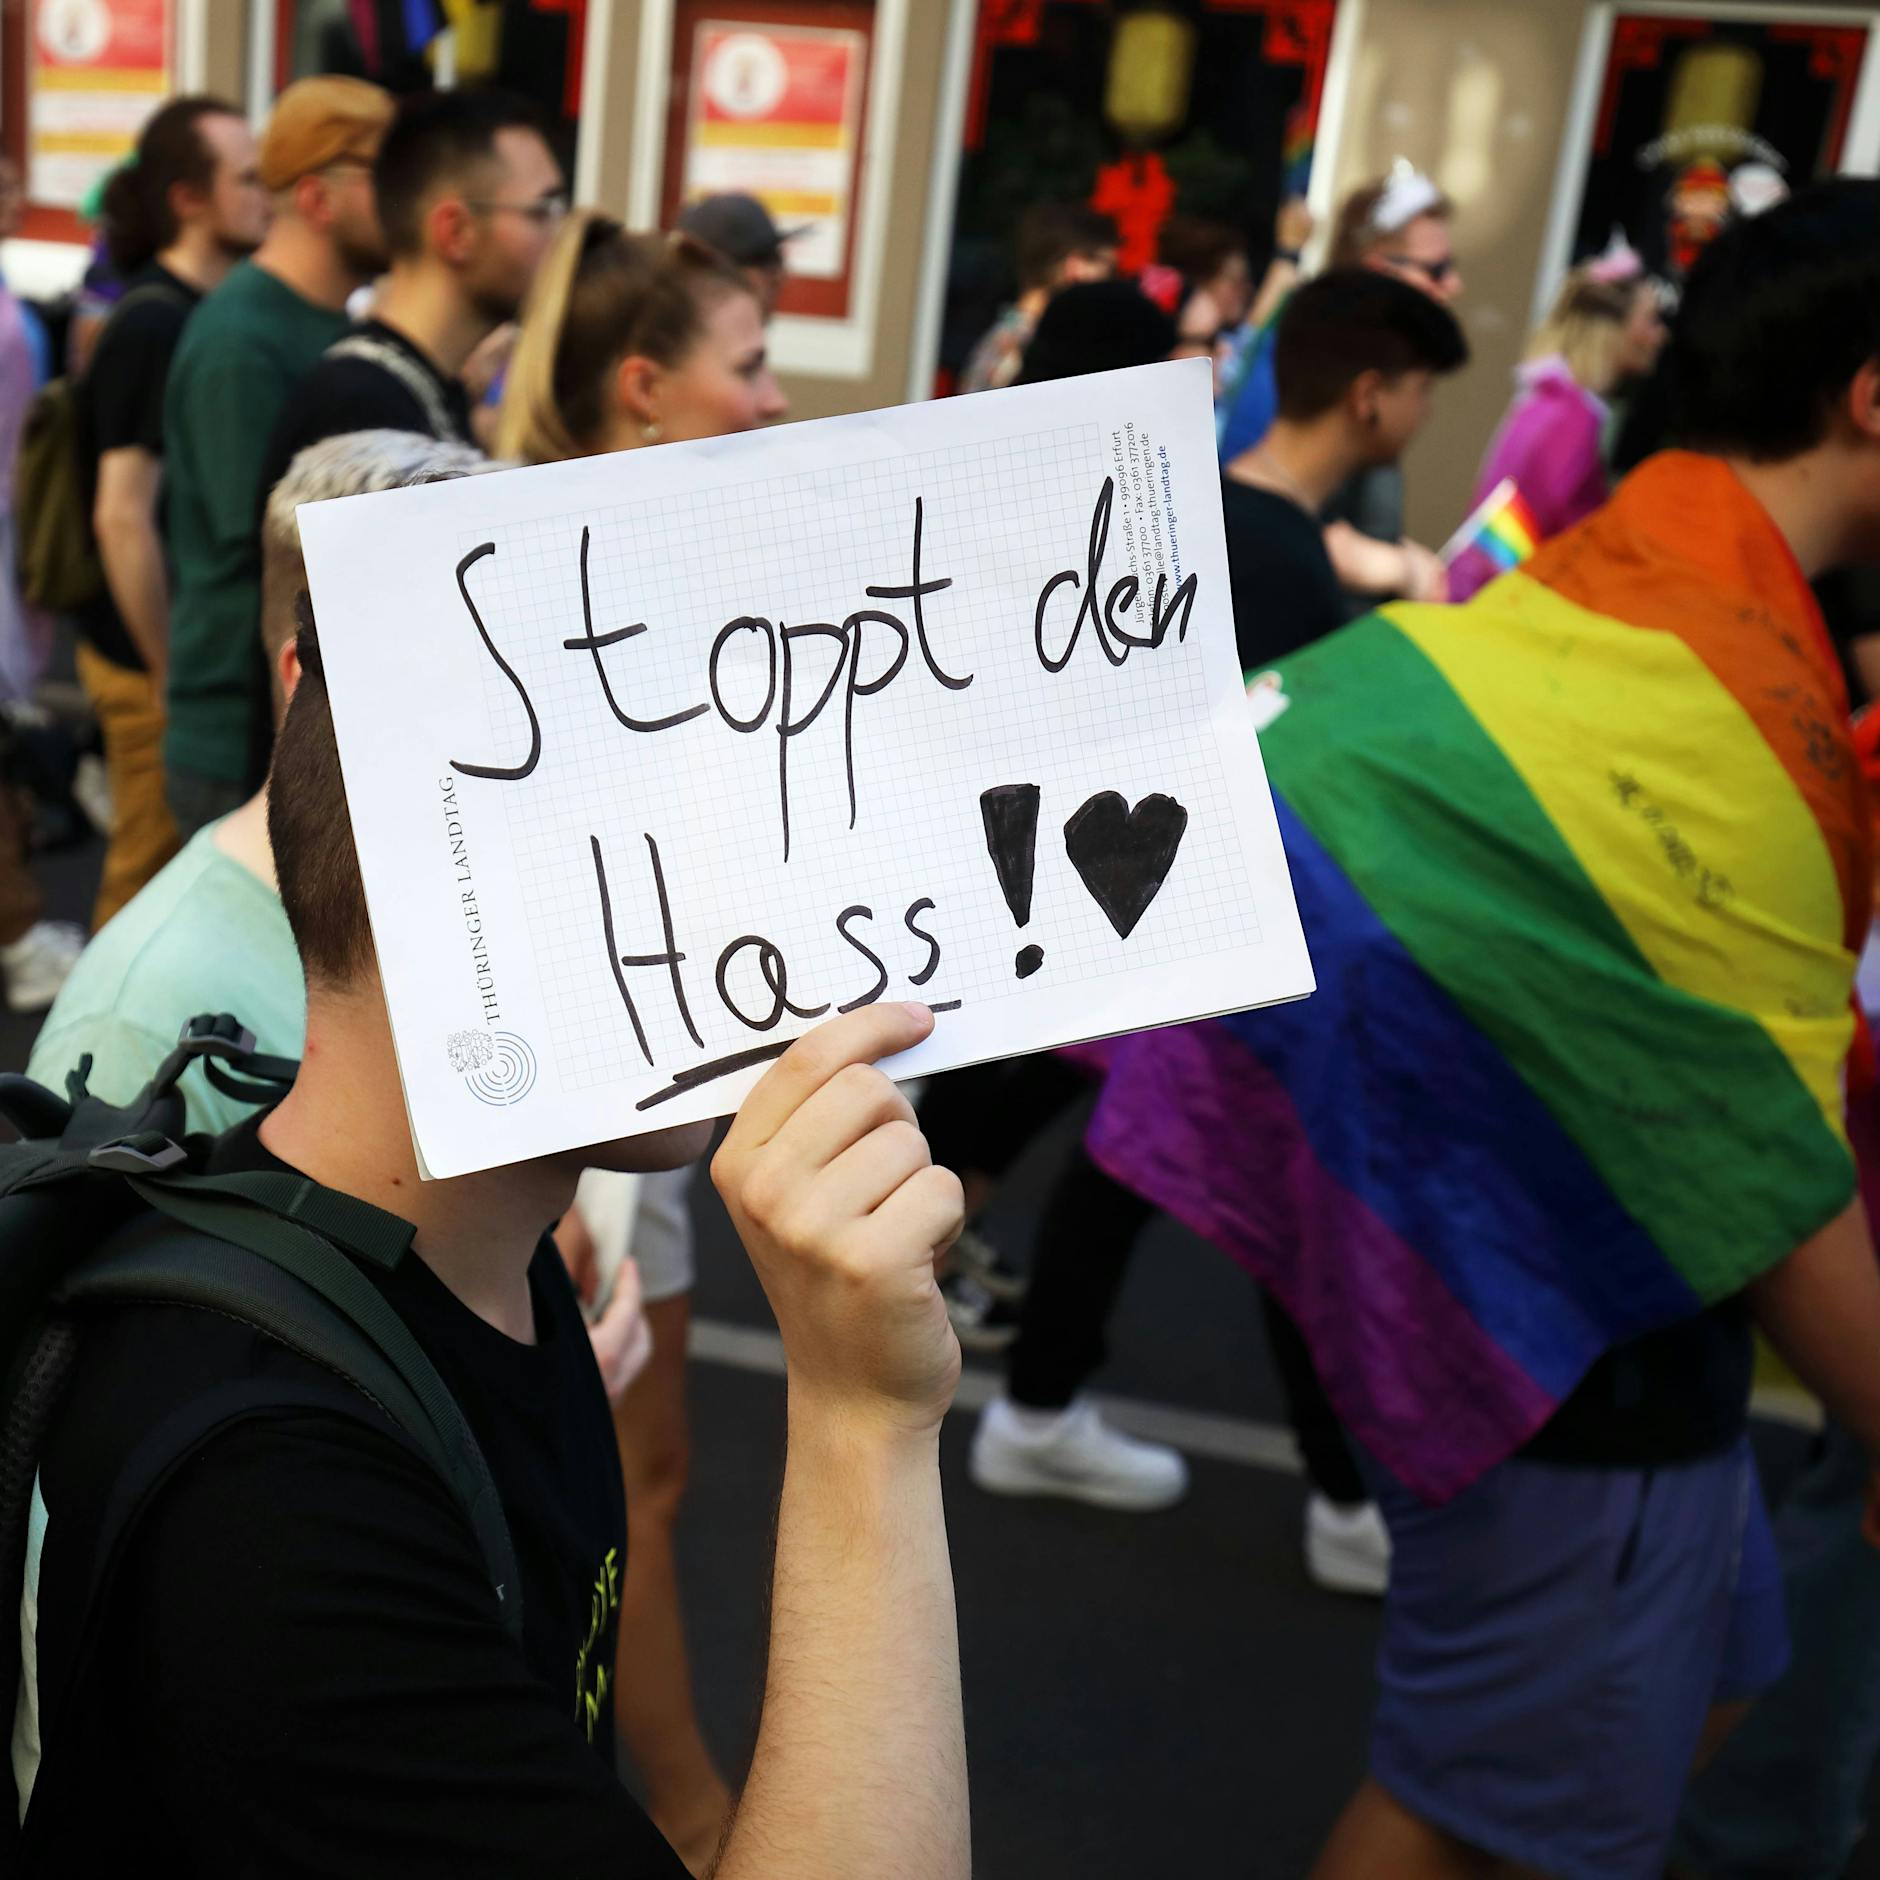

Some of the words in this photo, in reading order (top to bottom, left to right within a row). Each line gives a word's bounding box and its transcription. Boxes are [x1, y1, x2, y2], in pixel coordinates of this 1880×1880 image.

[1112, 430, 1123, 462] Erfurt
[1123, 422, 1140, 464] 3772016
[1115, 464, 1131, 501] 99096
[1130, 466, 1143, 491] 0361
[1135, 492, 1144, 514] Fax:
[1139, 526, 1153, 559] 37700
[1142, 561, 1155, 584] 0361
[449, 496, 974, 862] Stoppt
[1034, 477, 1198, 671] den
[438, 776, 472, 882] LANDTAG
[461, 889, 500, 1025] THÜRINGER
